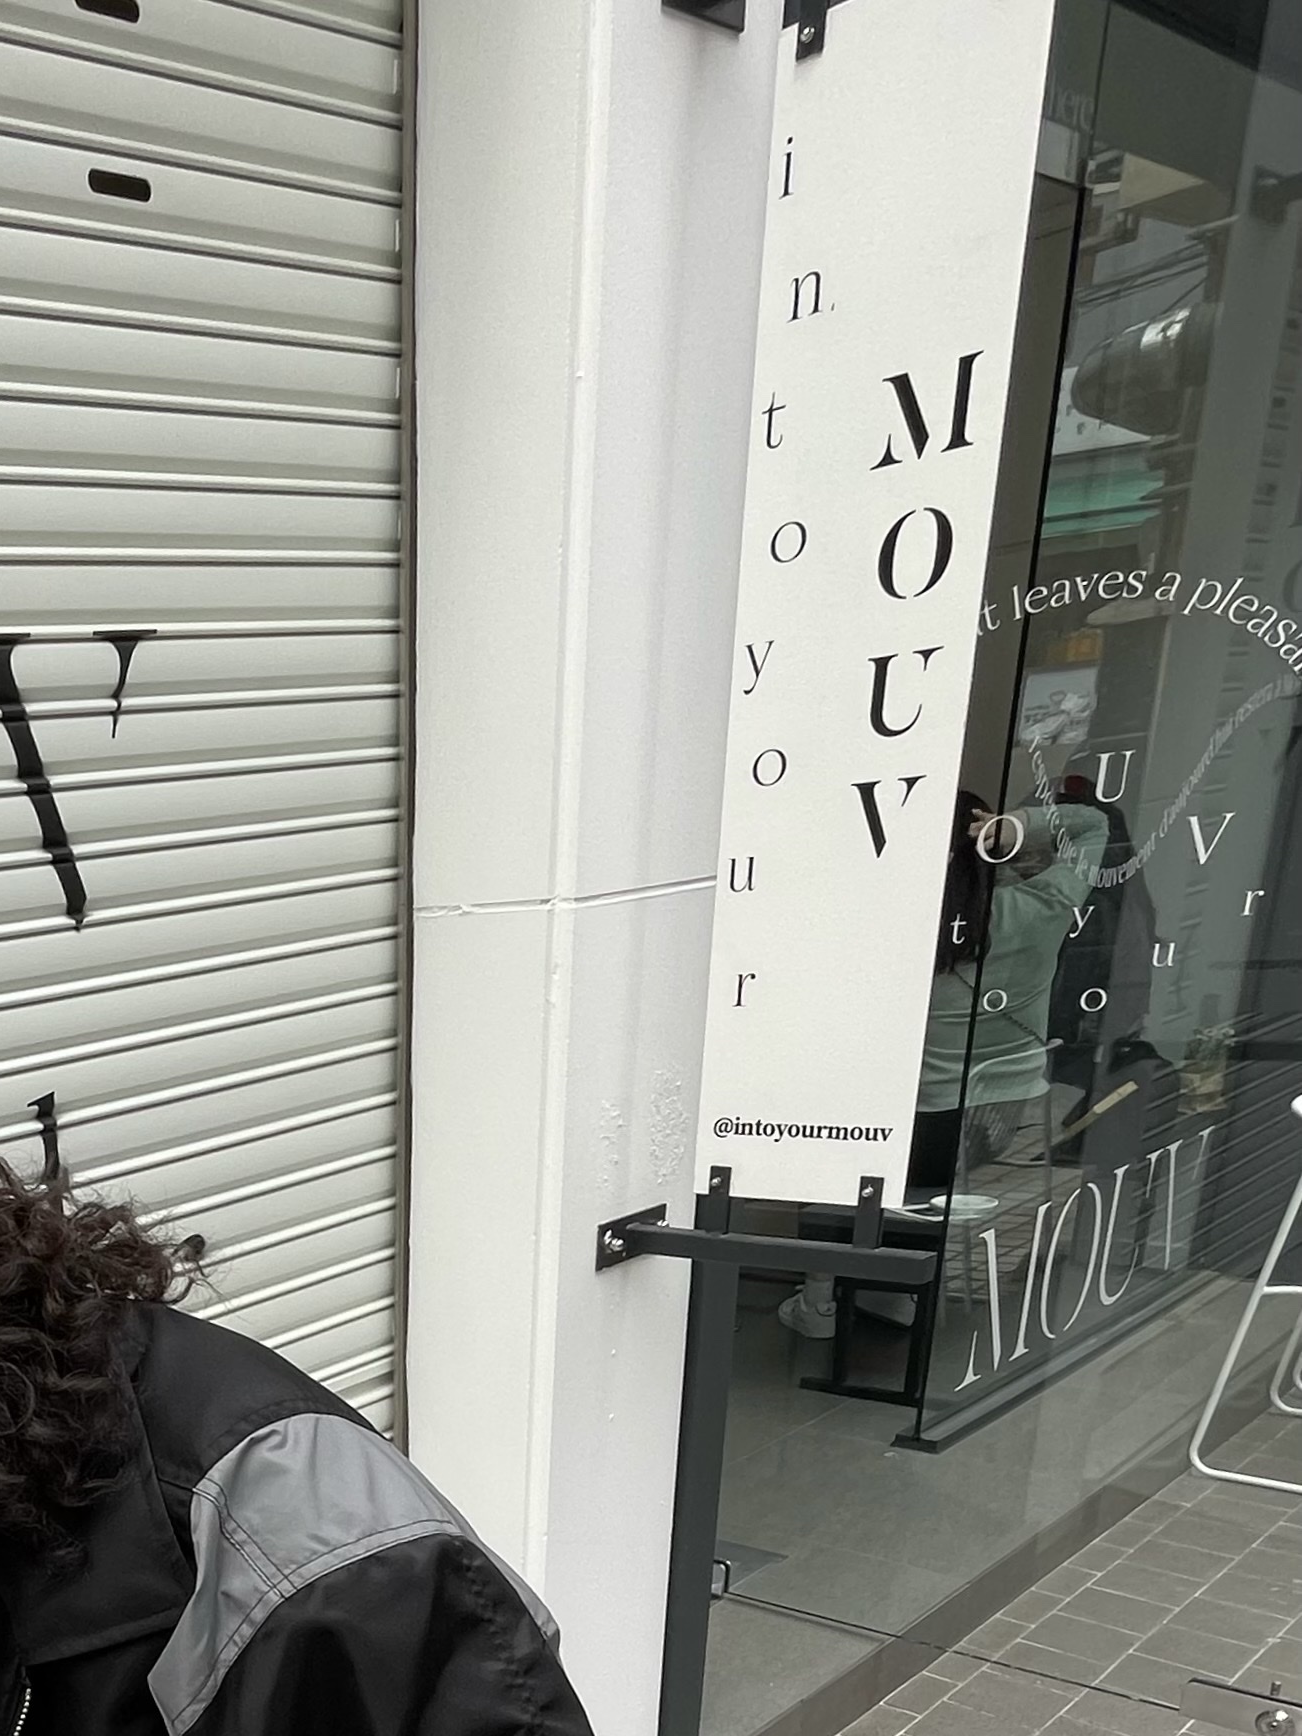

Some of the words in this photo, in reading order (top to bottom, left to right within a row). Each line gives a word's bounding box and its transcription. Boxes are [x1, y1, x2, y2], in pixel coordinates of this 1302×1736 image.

[851, 351, 983, 859] MOUV
[977, 599, 1001, 636] t
[1012, 569, 1147, 621] leaves
[1154, 571, 1182, 602] a
[713, 1116, 893, 1143] @intoyourmouv
